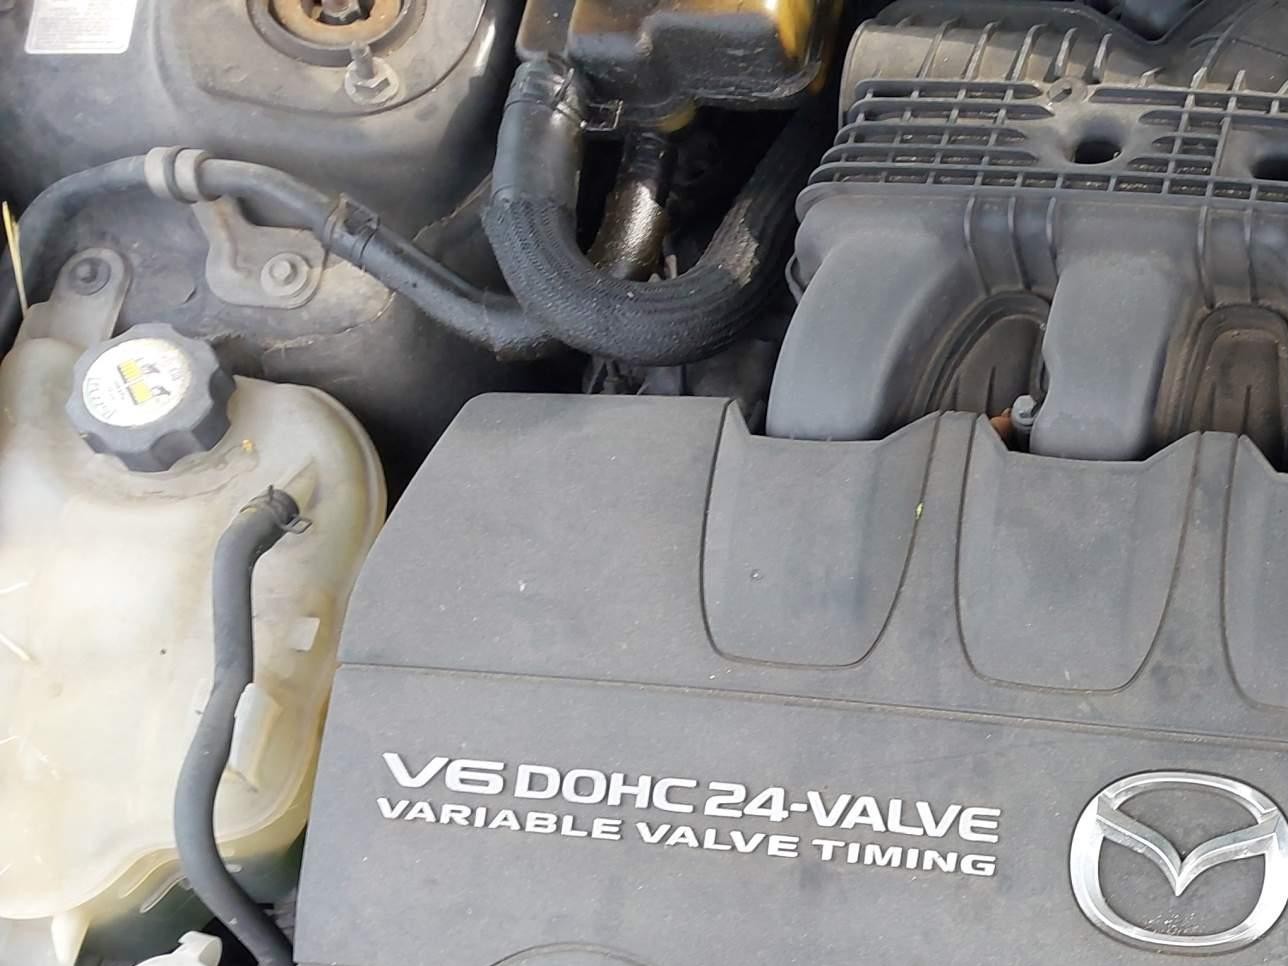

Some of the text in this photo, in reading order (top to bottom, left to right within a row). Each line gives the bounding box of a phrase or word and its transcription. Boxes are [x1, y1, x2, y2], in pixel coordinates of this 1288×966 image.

[376, 797, 998, 877] VARIABLE VALVE TIMING
[382, 752, 1001, 844] V6 DOHC 24-VALVE
